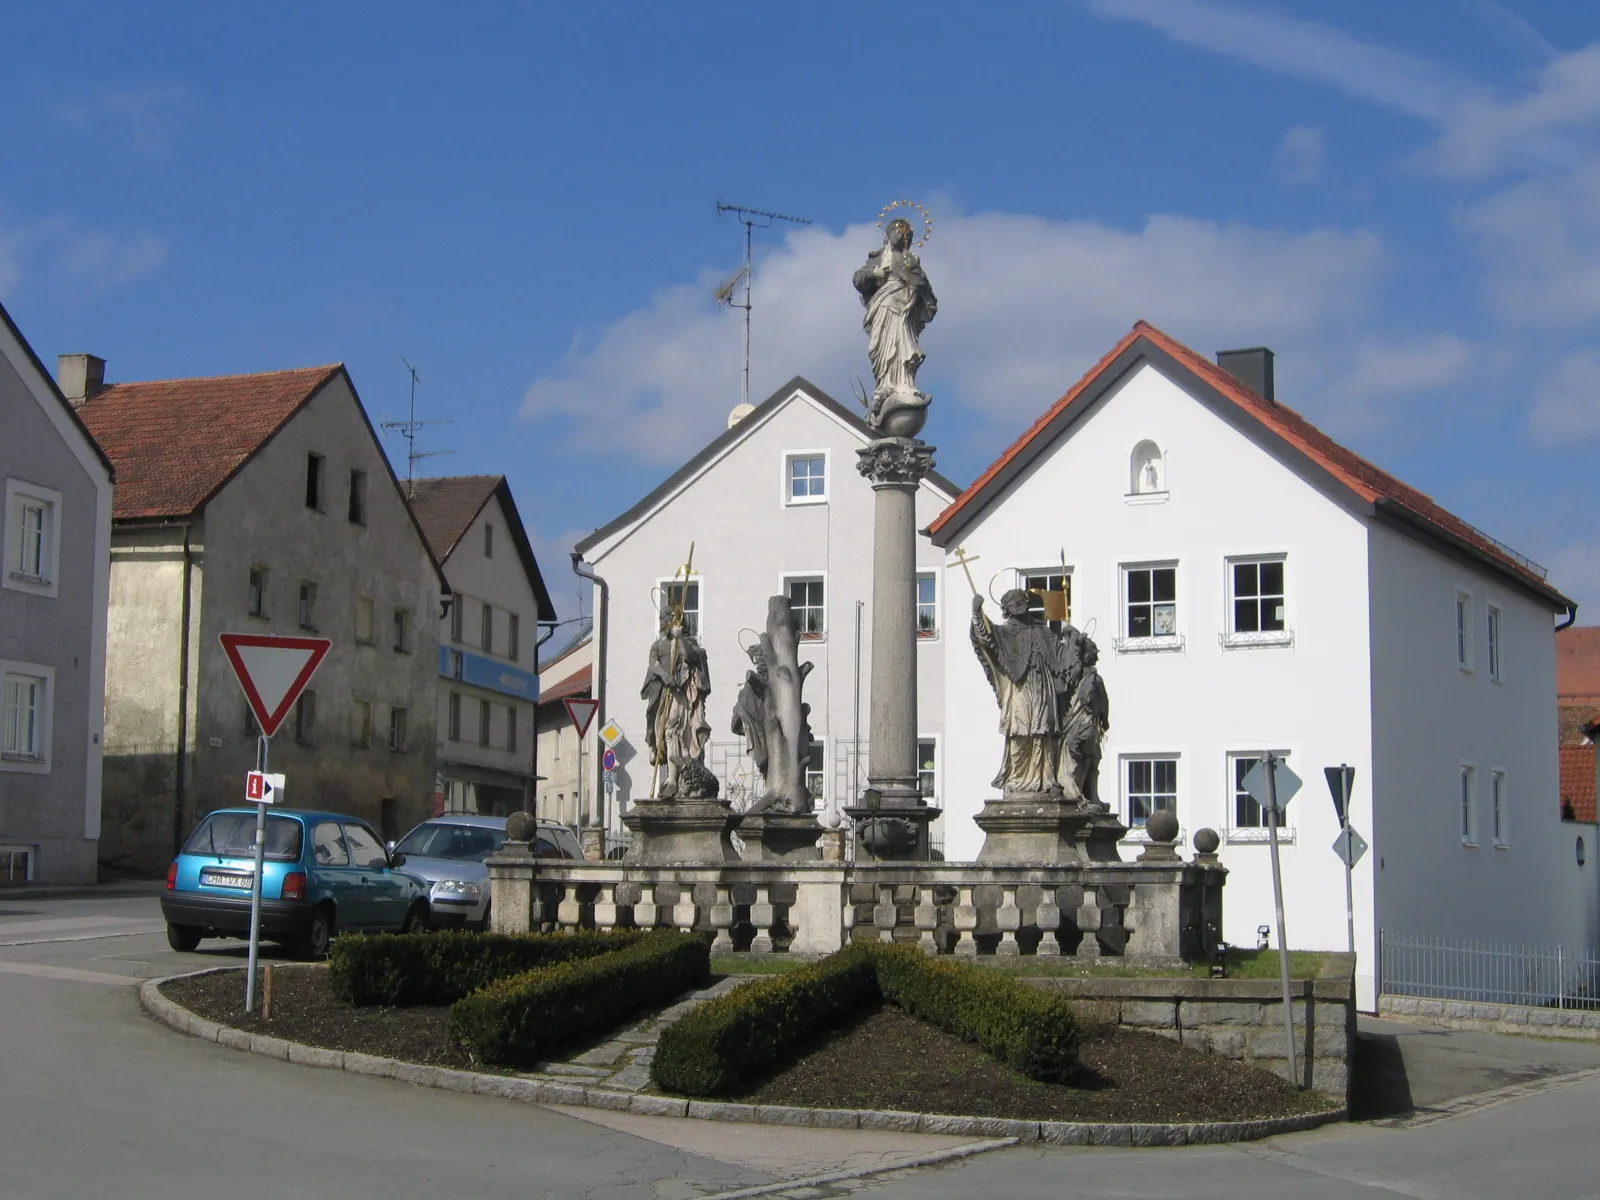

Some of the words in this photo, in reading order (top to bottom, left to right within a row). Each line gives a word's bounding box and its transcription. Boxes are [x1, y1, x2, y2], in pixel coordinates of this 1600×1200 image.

[251, 778, 258, 795] i
[207, 874, 222, 884] CHA
[228, 876, 239, 885] VX
[240, 877, 252, 887] 88
